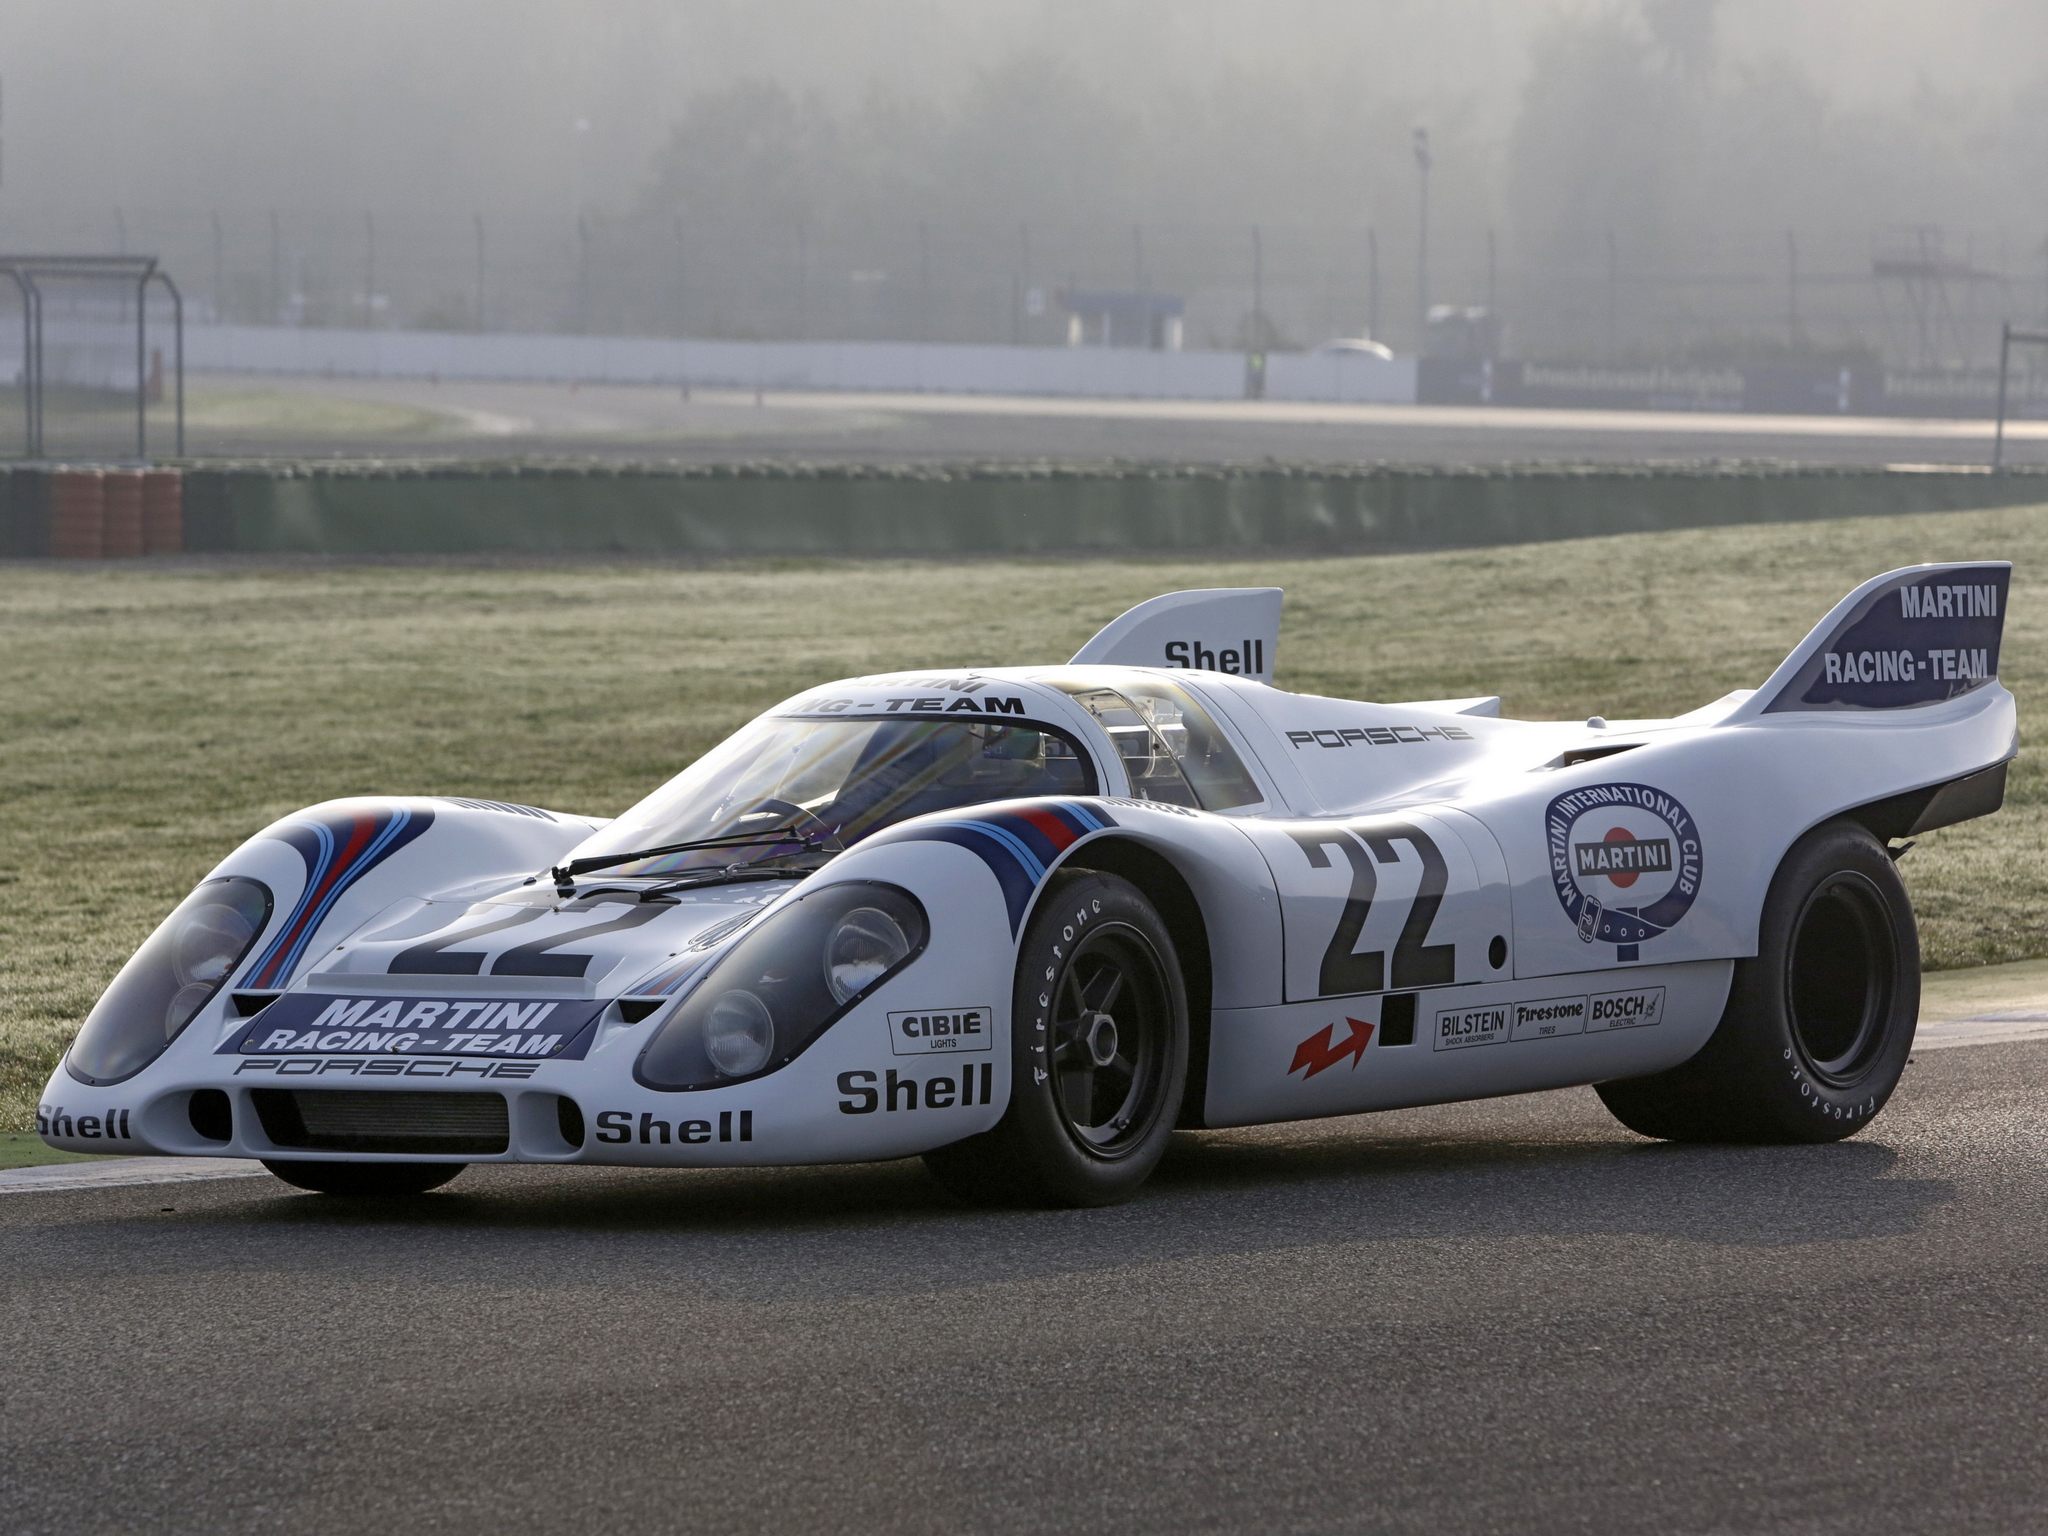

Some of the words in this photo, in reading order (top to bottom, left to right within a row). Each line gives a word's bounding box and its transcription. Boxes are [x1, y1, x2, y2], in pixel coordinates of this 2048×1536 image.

[1900, 585, 1997, 618] MARTINI
[1165, 639, 1263, 675] Shell
[1285, 726, 1475, 750] PORSCHE
[1556, 786, 1687, 836] INTERNATIONAL
[1551, 815, 1577, 907] MARTINI
[1580, 844, 1667, 870] MARTINI
[1681, 839, 1698, 895] CLUB
[1281, 821, 1455, 996] 22
[387, 889, 674, 977] 22
[1030, 899, 1101, 1085] Firestone
[1592, 996, 1644, 1020] BOSCH
[311, 999, 559, 1030] MARTINI
[1441, 1011, 1504, 1037] BILSTEIN
[1516, 1003, 1584, 1027] Firestone
[1538, 1026, 1556, 1035] TIRES
[1609, 1018, 1636, 1027] ELECTRIC
[930, 1038, 957, 1048] LIGHTS
[1445, 1033, 1463, 1046] SHOCK
[1464, 1033, 1494, 1043] ABSORBERS
[233, 1059, 541, 1079] PORSCHE
[836, 1063, 993, 1115] Shell
[36, 1104, 131, 1139] Shell
[595, 1110, 753, 1144] Shell
